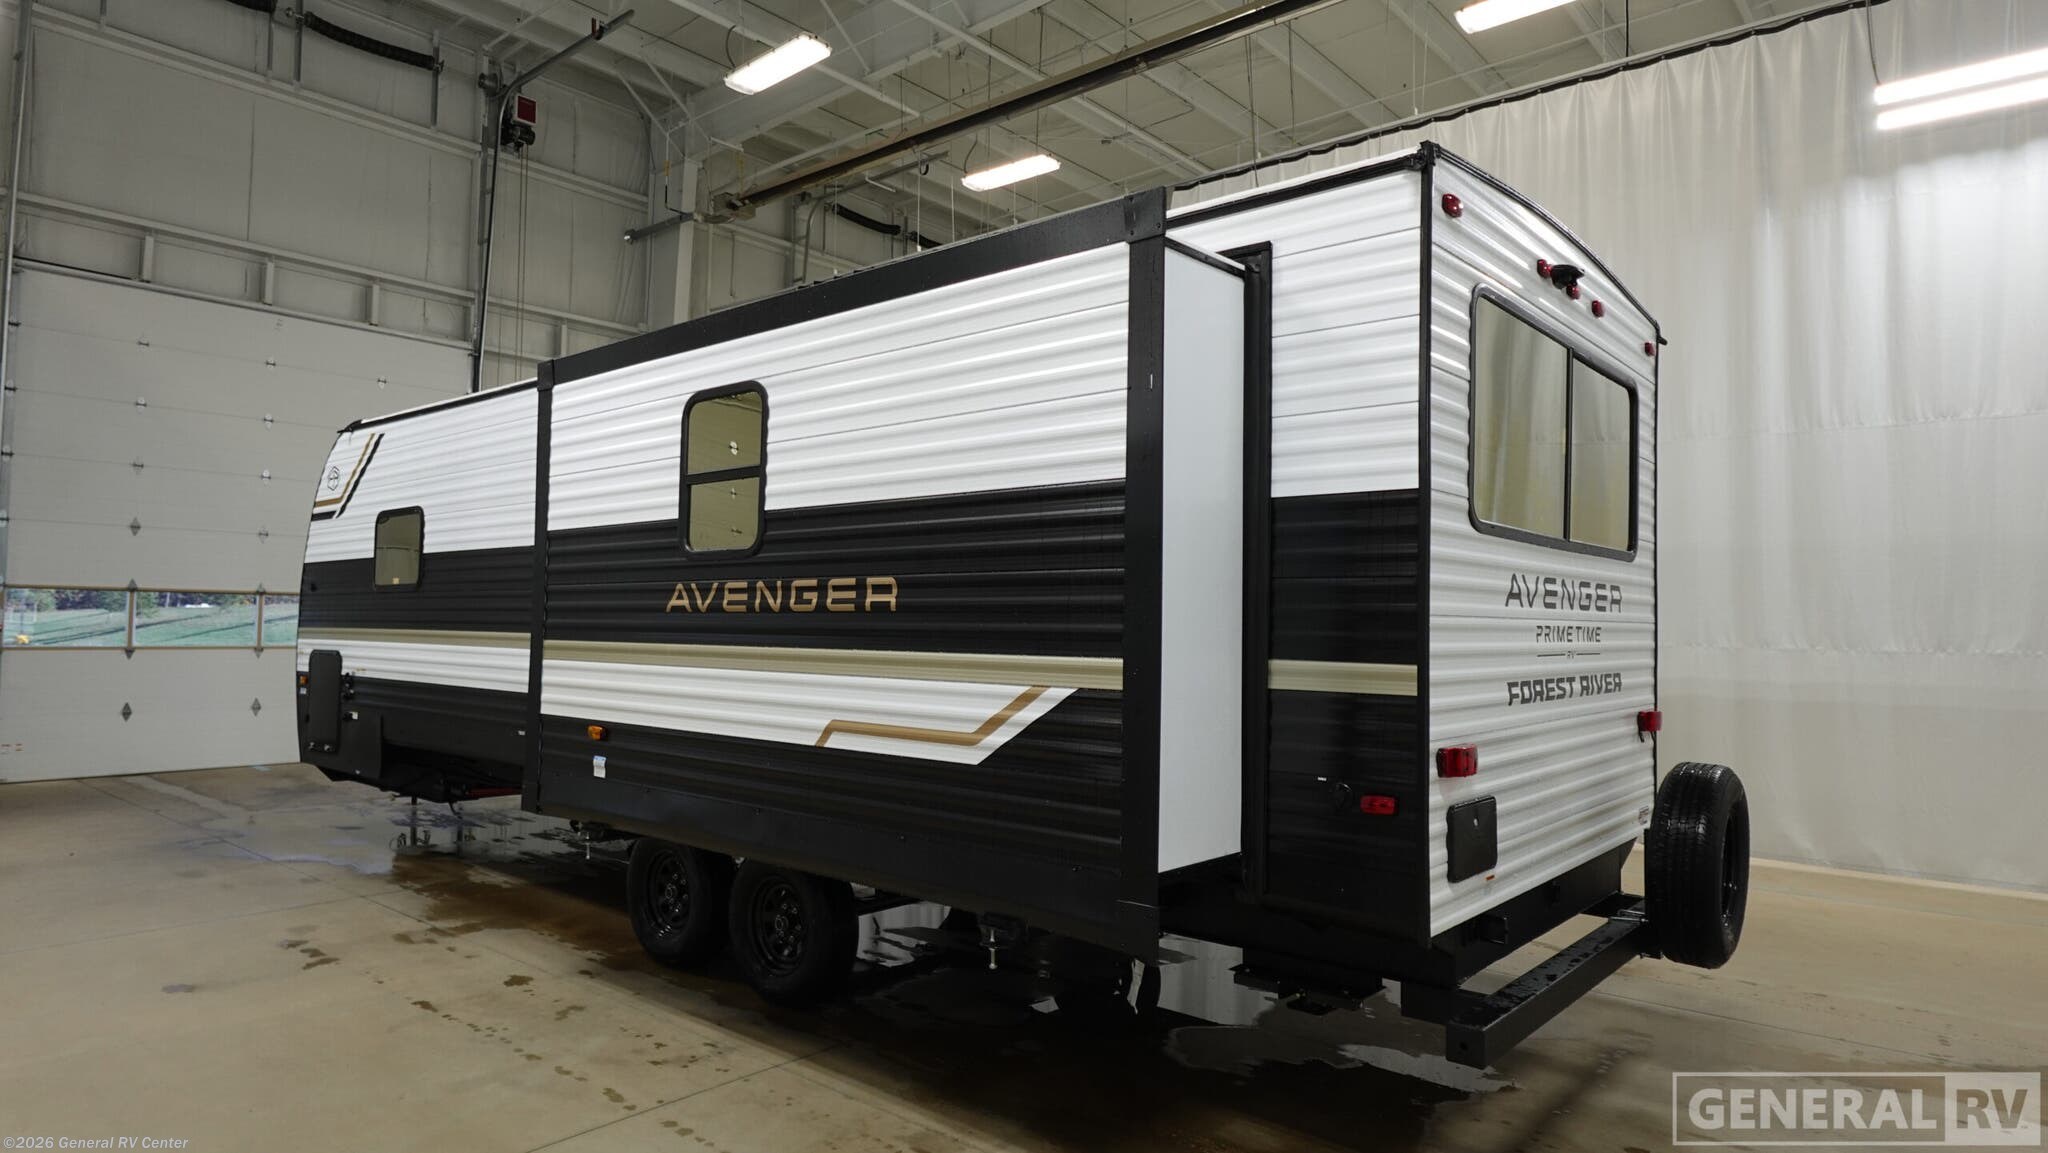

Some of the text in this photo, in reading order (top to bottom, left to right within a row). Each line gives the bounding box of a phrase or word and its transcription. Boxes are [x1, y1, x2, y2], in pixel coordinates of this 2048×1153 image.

[666, 577, 898, 613] AVENGER
[1505, 573, 1622, 613] AVENGER
[1507, 673, 1622, 706] FOREST RIVER
